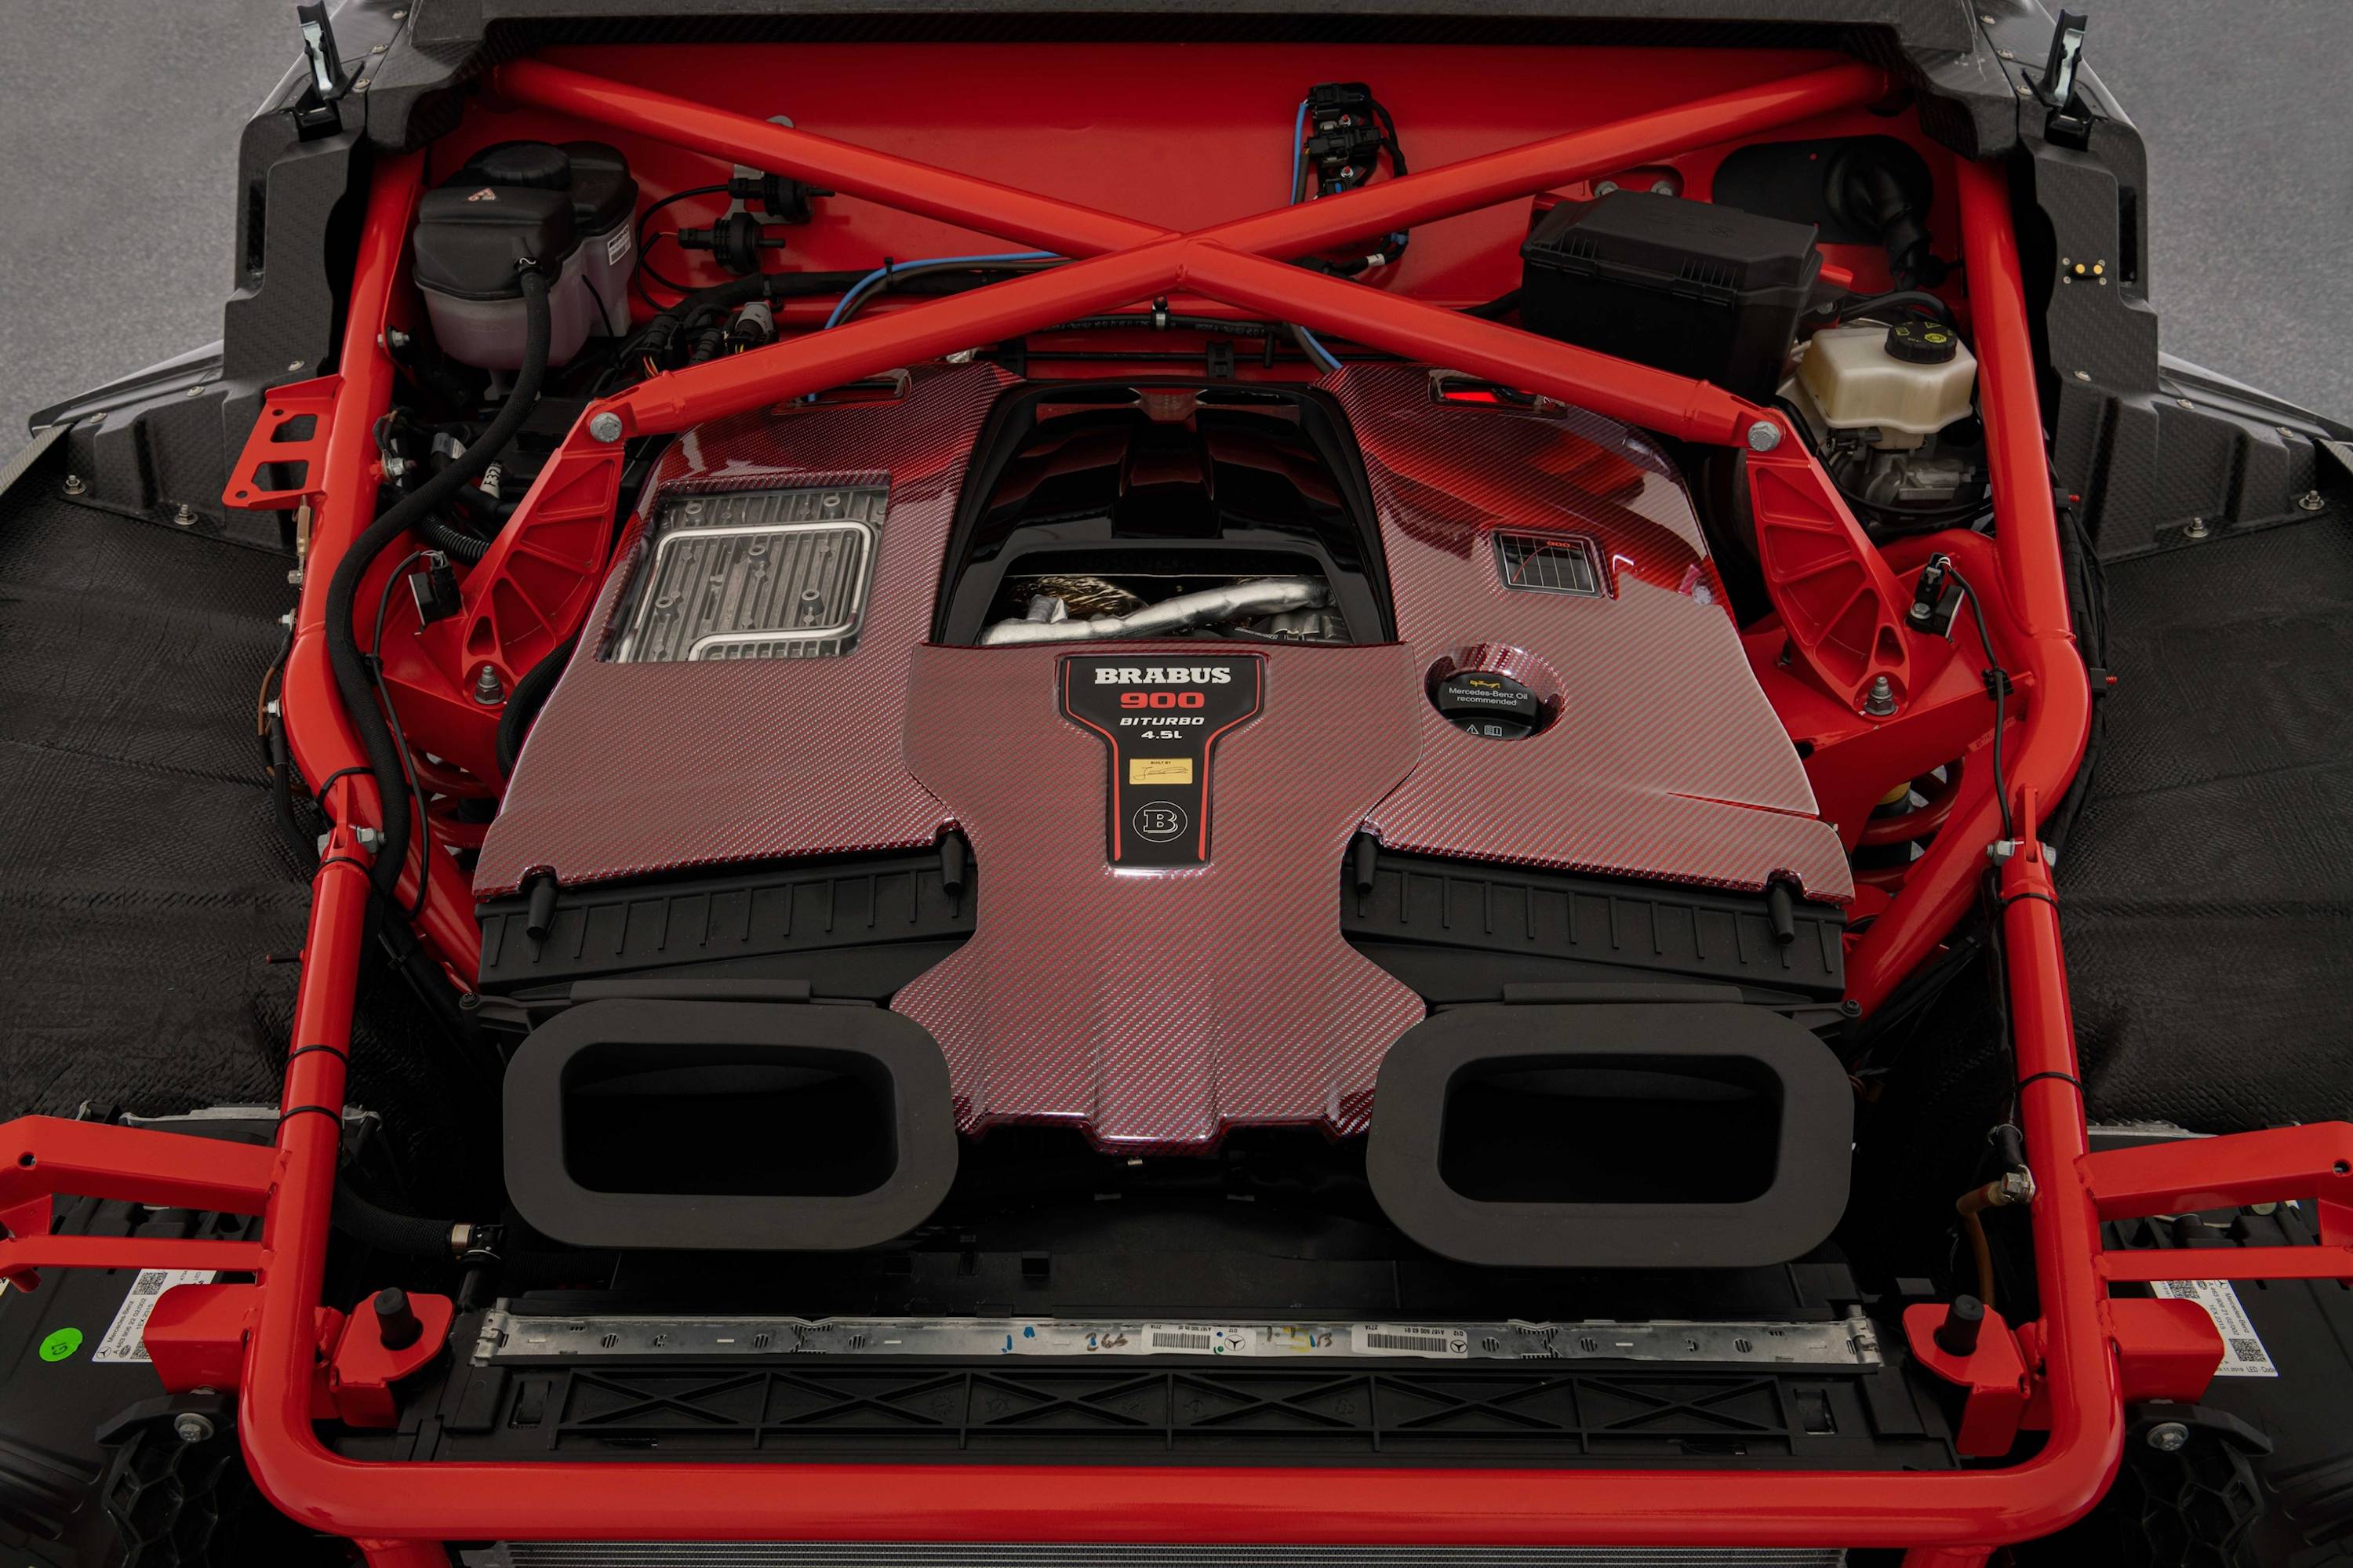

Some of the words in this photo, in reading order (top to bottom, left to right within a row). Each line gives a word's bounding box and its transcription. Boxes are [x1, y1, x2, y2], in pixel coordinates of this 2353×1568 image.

[1095, 668, 1231, 684] BRABUS
[1120, 692, 1205, 708] 900
[1449, 687, 1514, 699] Mercedes-Benz
[1457, 696, 1517, 706] recommended
[1119, 717, 1205, 726] BITURBO
[1141, 730, 1182, 739] 4.5L
[2225, 1293, 2249, 1333] Mercedes-Benz
[107, 1301, 133, 1342] Mercedes-Benz
